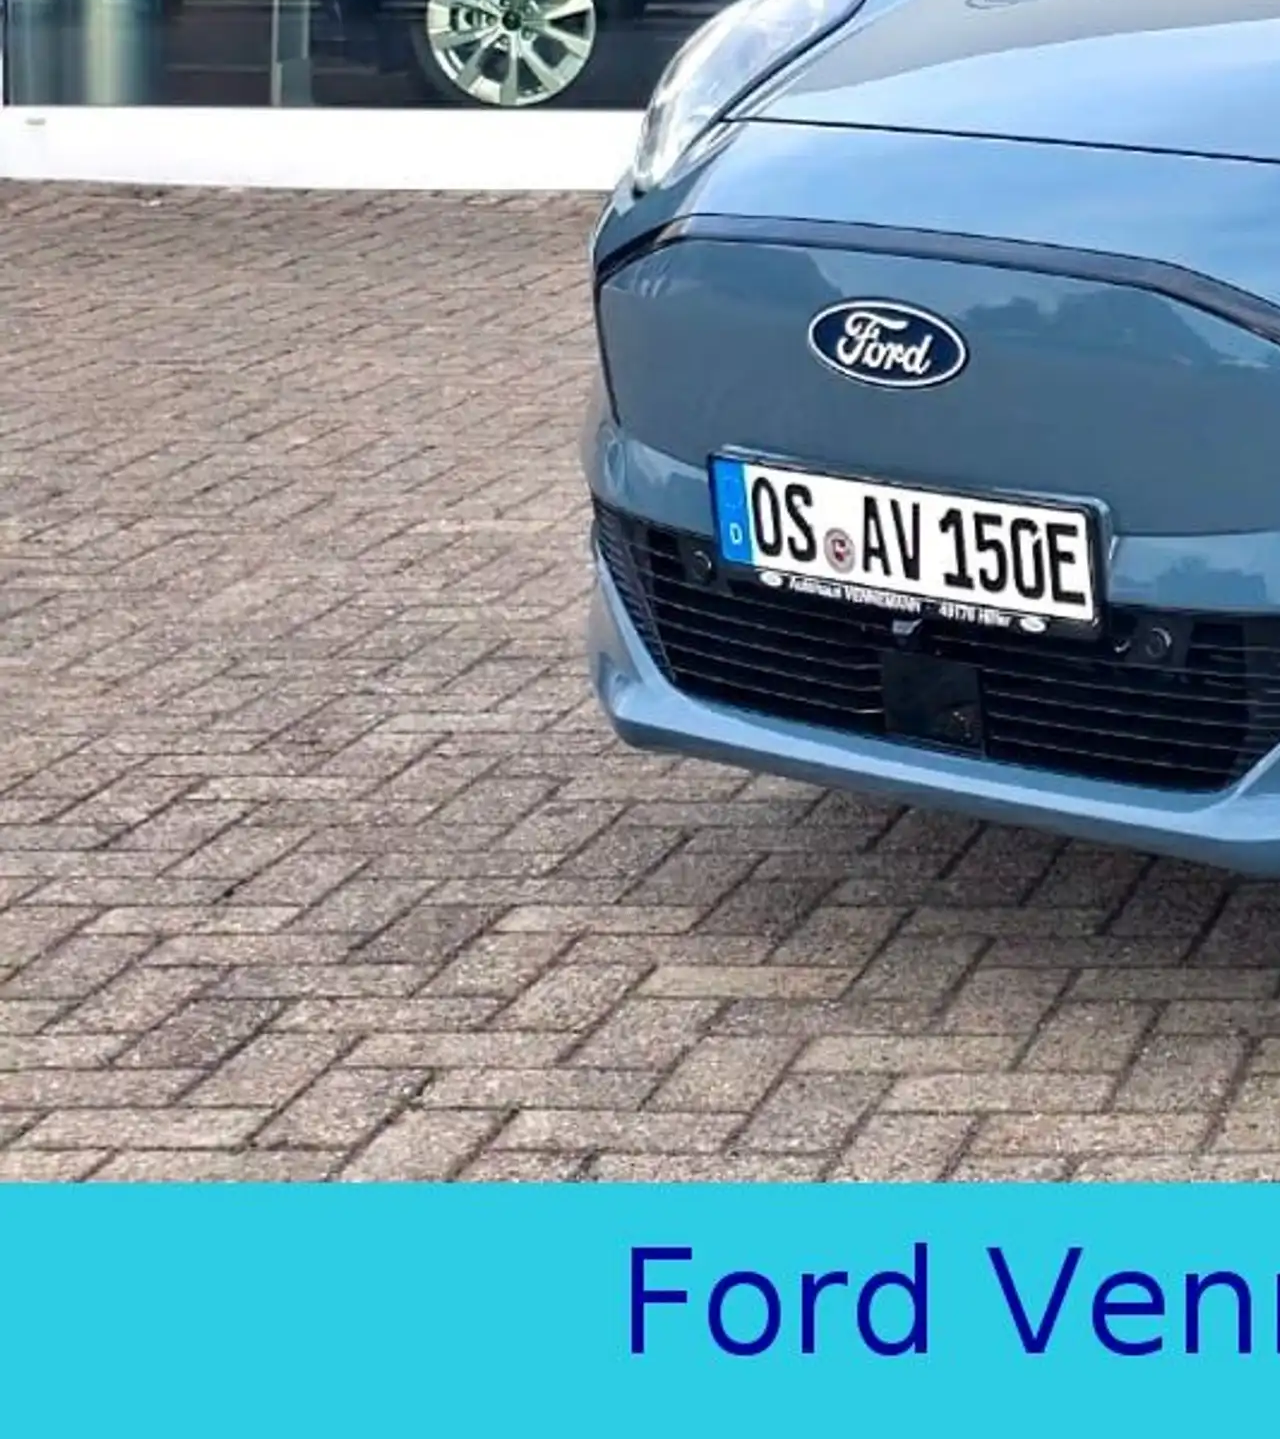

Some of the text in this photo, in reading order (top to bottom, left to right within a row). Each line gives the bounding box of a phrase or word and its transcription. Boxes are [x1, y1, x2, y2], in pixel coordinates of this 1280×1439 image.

[835, 310, 933, 376] Ford
[730, 524, 744, 546] D
[750, 476, 1088, 607] OS AV 150E
